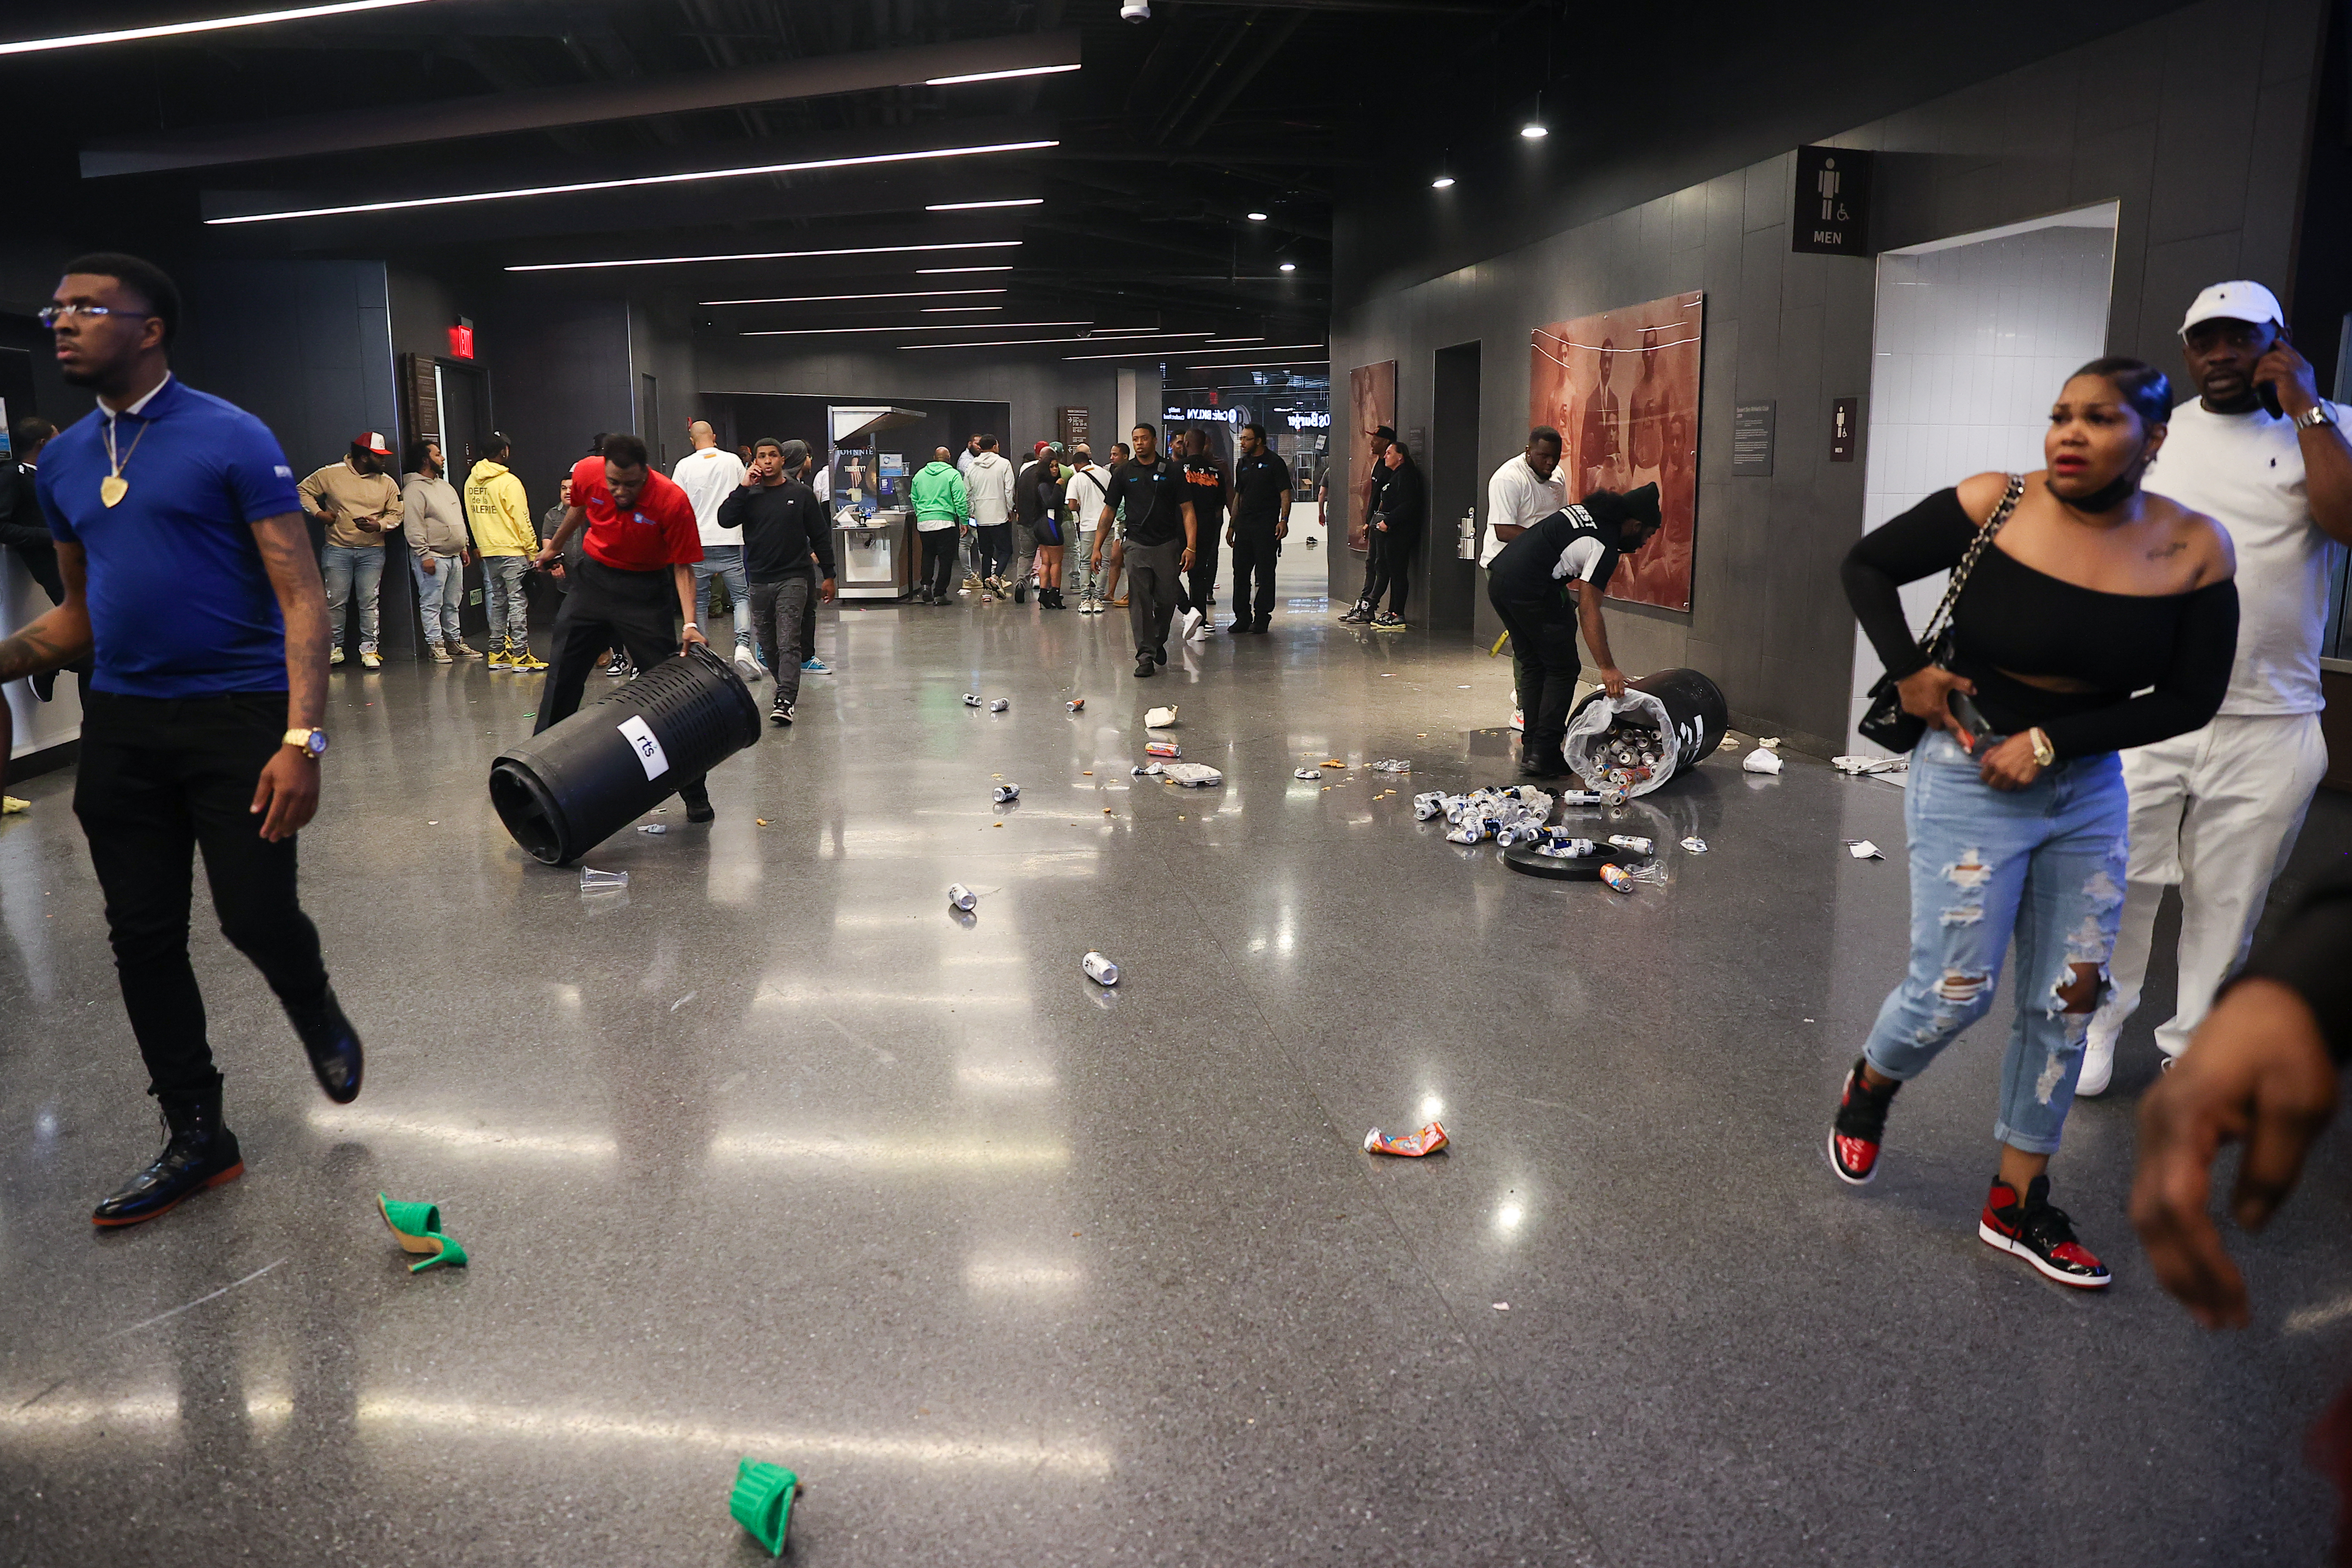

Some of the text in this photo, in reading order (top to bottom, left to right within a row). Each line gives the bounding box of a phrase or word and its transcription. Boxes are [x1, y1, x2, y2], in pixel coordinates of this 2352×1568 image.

[1814, 231, 1842, 244] MEN
[461, 328, 471, 356] EXIT
[469, 485, 489, 495] DÉPT.
[1571, 504, 1598, 530] BEST
[637, 736, 654, 757] rts
